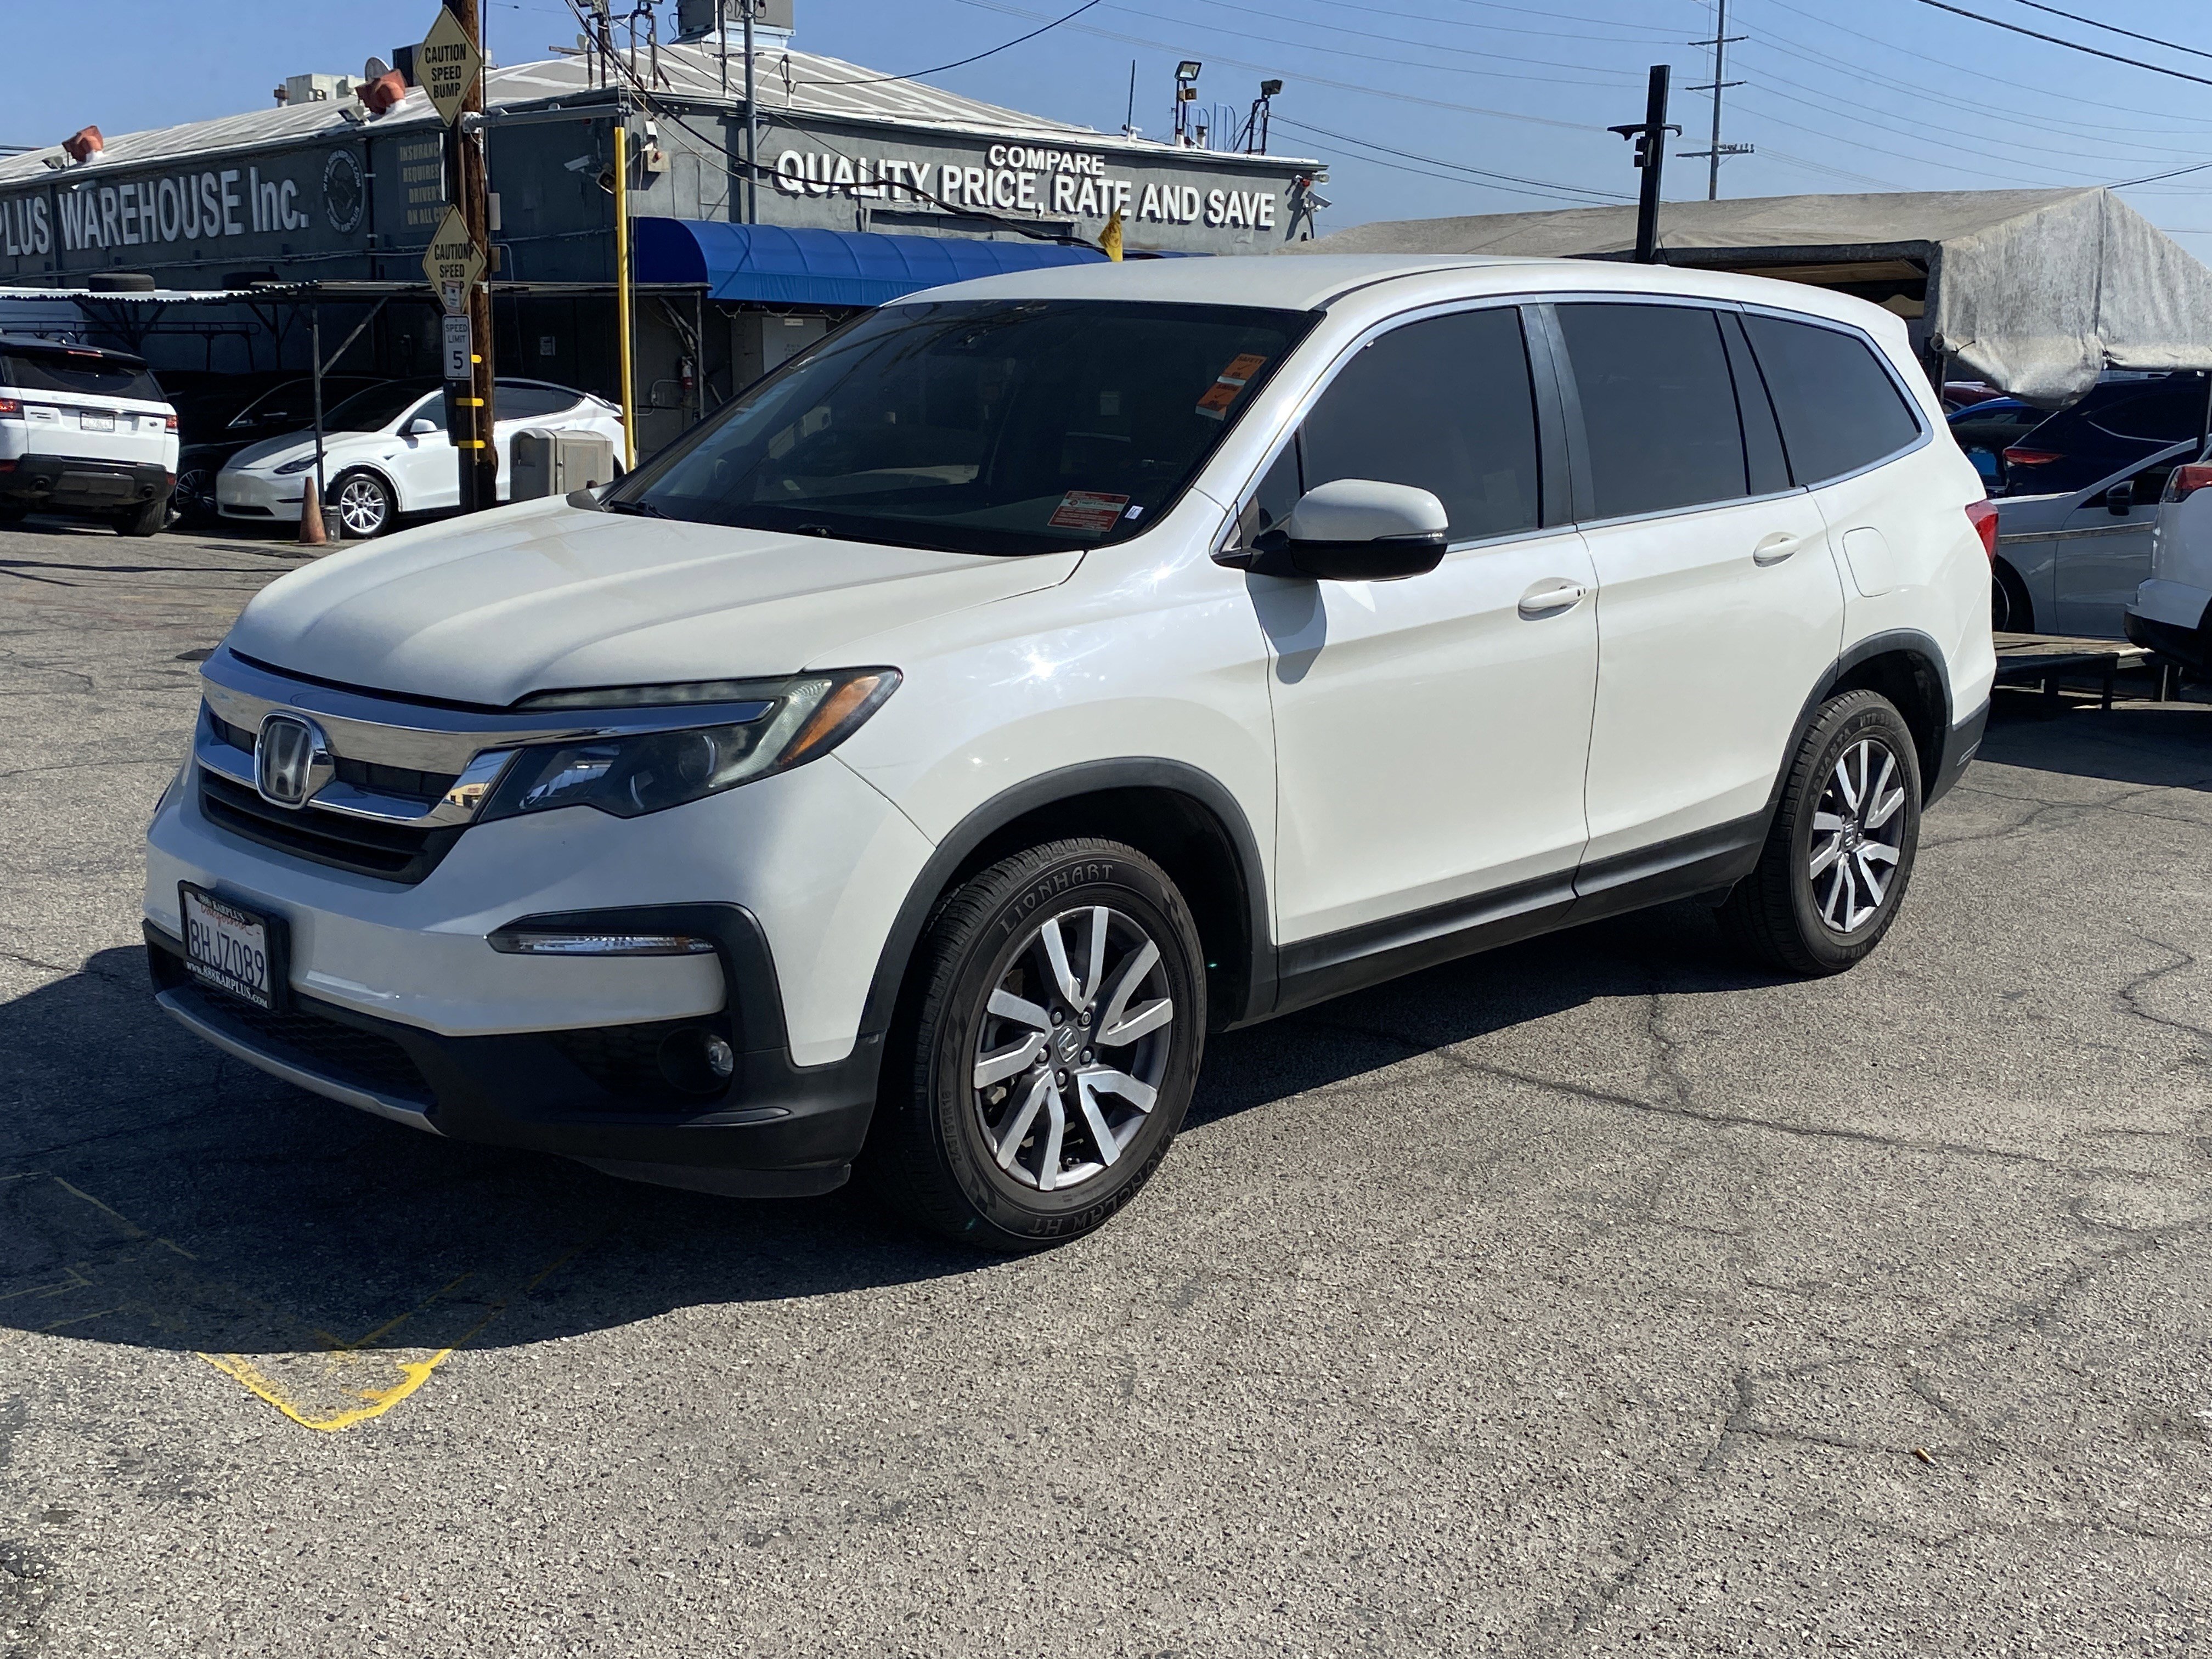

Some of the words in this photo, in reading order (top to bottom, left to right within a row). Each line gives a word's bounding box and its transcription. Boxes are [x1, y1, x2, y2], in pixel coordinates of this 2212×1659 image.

[425, 43, 466, 64] CAUTION
[431, 65, 461, 81] SPEED
[433, 83, 460, 98] BUMP
[399, 141, 439, 162] INSURANC
[989, 144, 1105, 176] COMPARE
[777, 150, 935, 208] QUALITY,
[942, 165, 1044, 217] PRICE,
[1055, 174, 1132, 216] RATE
[1141, 183, 1200, 221] AND
[1207, 189, 1276, 227] SAVE
[0, 196, 49, 256] LUS
[58, 169, 245, 250] WAREHOUSE
[250, 166, 309, 232] Inc.
[435, 243, 469, 261] CAUTION
[439, 264, 465, 278] SPEED
[441, 280, 465, 295] BP
[445, 324, 467, 332] SPEED
[448, 335, 466, 343] LIMIT
[453, 351, 464, 369] 5
[1809, 727, 1852, 804] ADVANTA
[1000, 864, 1114, 936] LIONHART
[189, 918, 264, 989] 8HJZ089
[1026, 1217, 1064, 1236] HT
